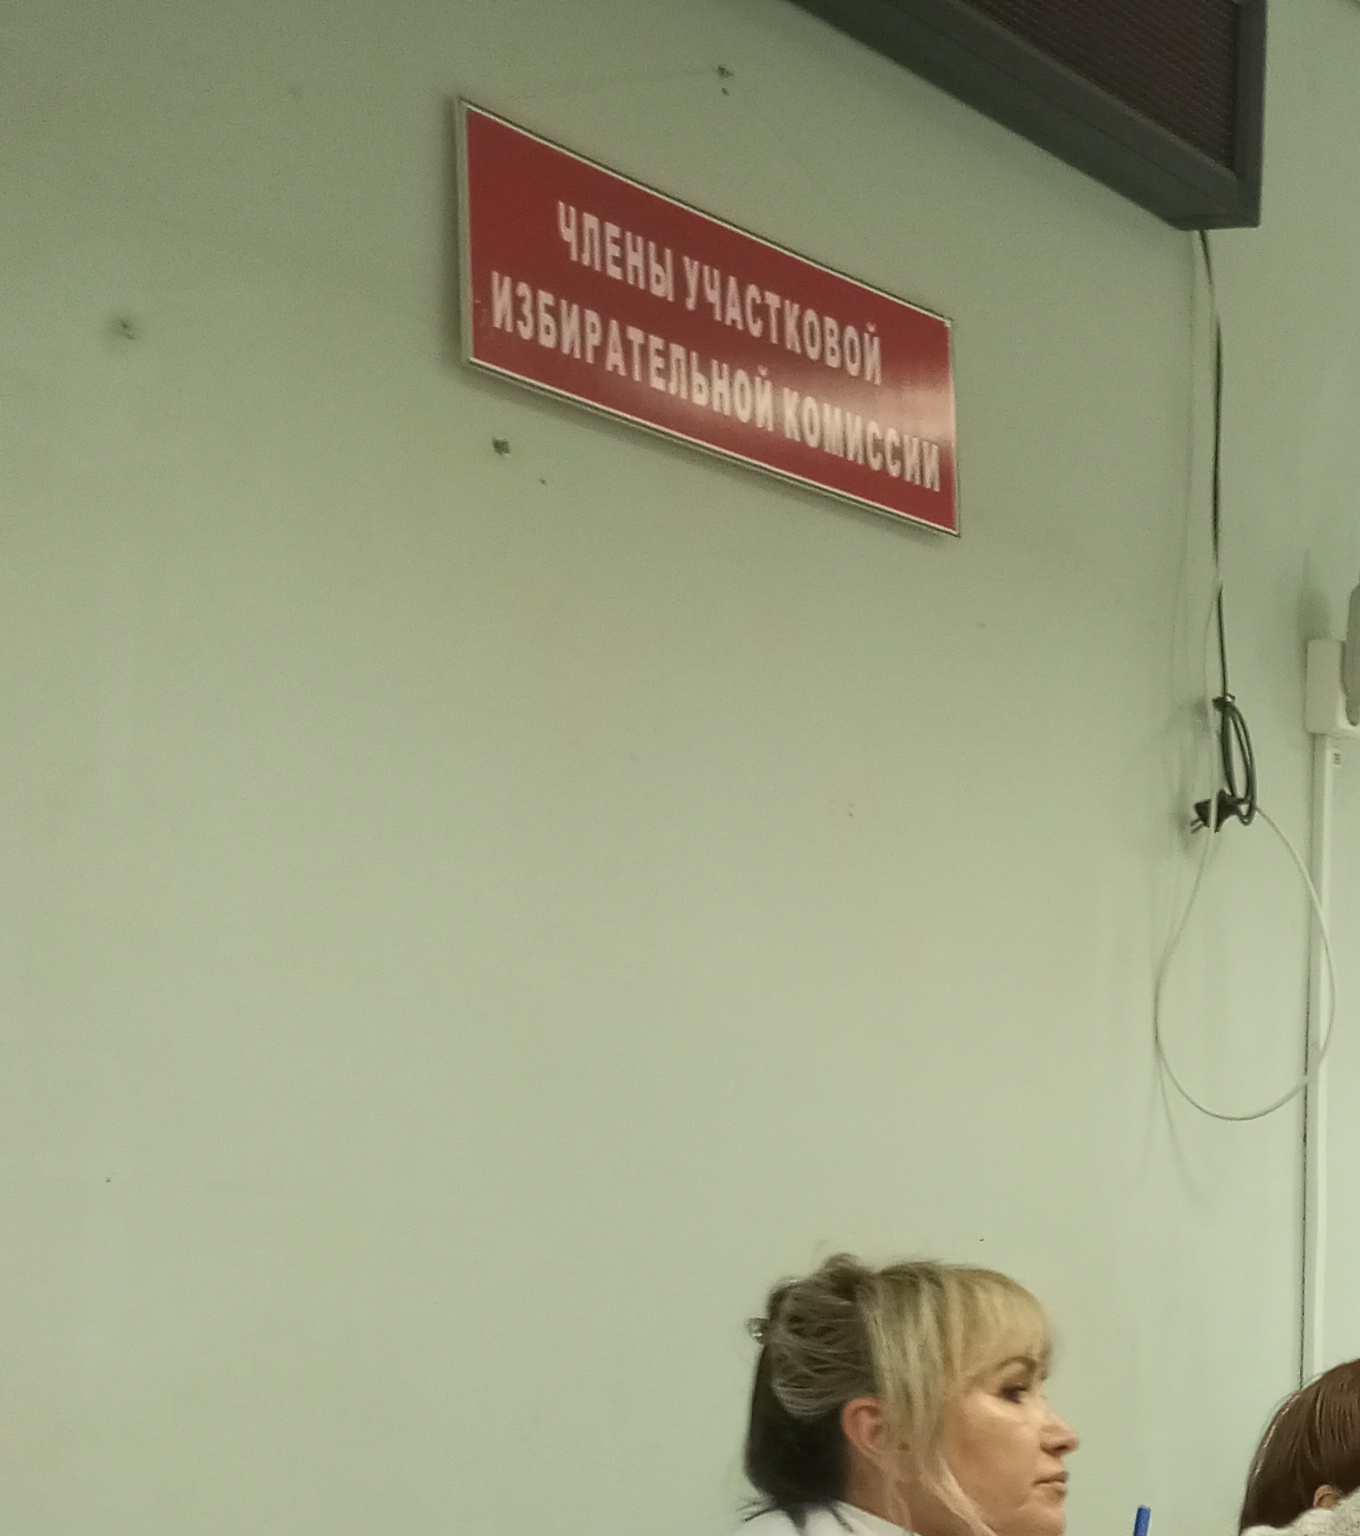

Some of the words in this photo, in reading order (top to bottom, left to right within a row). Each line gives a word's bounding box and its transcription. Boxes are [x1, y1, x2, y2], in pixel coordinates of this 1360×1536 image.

[490, 271, 774, 432] ИЗБИРАТЕЛЬНОЙ
[782, 387, 941, 492] КОМИССИИ
[557, 201, 674, 302] ЧЛЕНЫ
[683, 254, 882, 385] УЧАСТКОВОЙ
